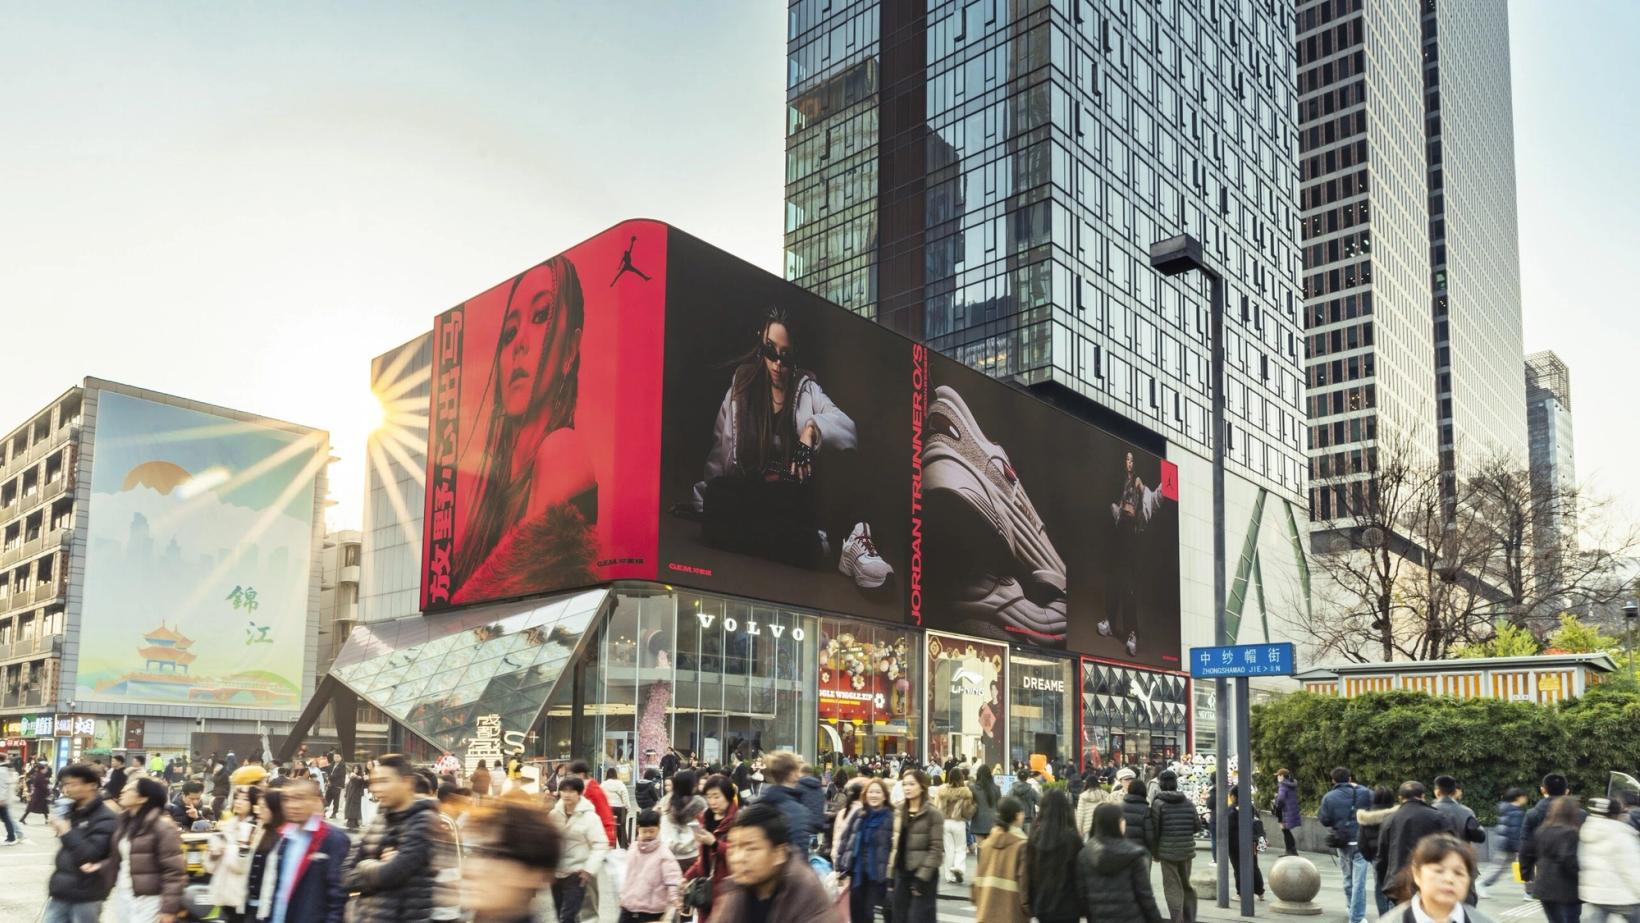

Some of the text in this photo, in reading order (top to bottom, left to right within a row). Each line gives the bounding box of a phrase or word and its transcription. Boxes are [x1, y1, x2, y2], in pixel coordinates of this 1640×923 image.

[430, 310, 463, 604] 放野心出马
[912, 392, 923, 515] TRUNNER
[911, 518, 922, 626] JORDAN
[696, 613, 804, 641] VOLVO
[1200, 648, 1280, 666] 中纱帽街
[1202, 666, 1246, 675] ZHONGSHAMAO
[1023, 676, 1065, 693] DREAME
